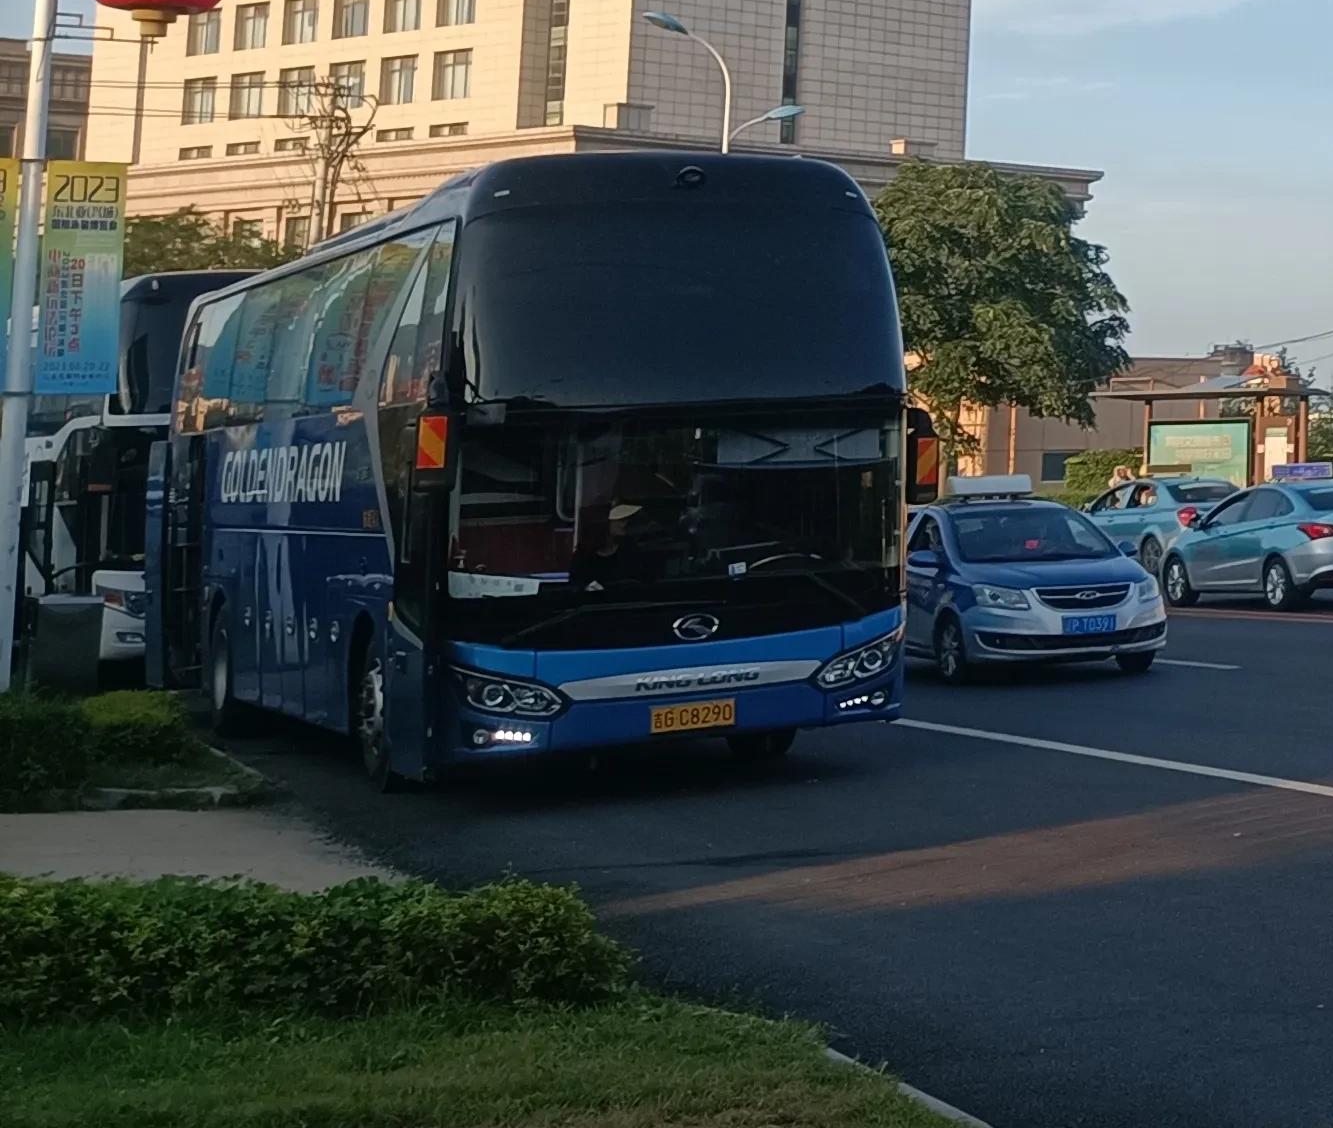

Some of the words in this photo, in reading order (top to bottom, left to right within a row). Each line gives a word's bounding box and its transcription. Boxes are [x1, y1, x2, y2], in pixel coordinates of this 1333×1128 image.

[53, 175, 120, 203] 2023
[220, 440, 347, 503] GOLDENDRAGON
[635, 674, 691, 691] KING
[697, 668, 760, 686] LONG
